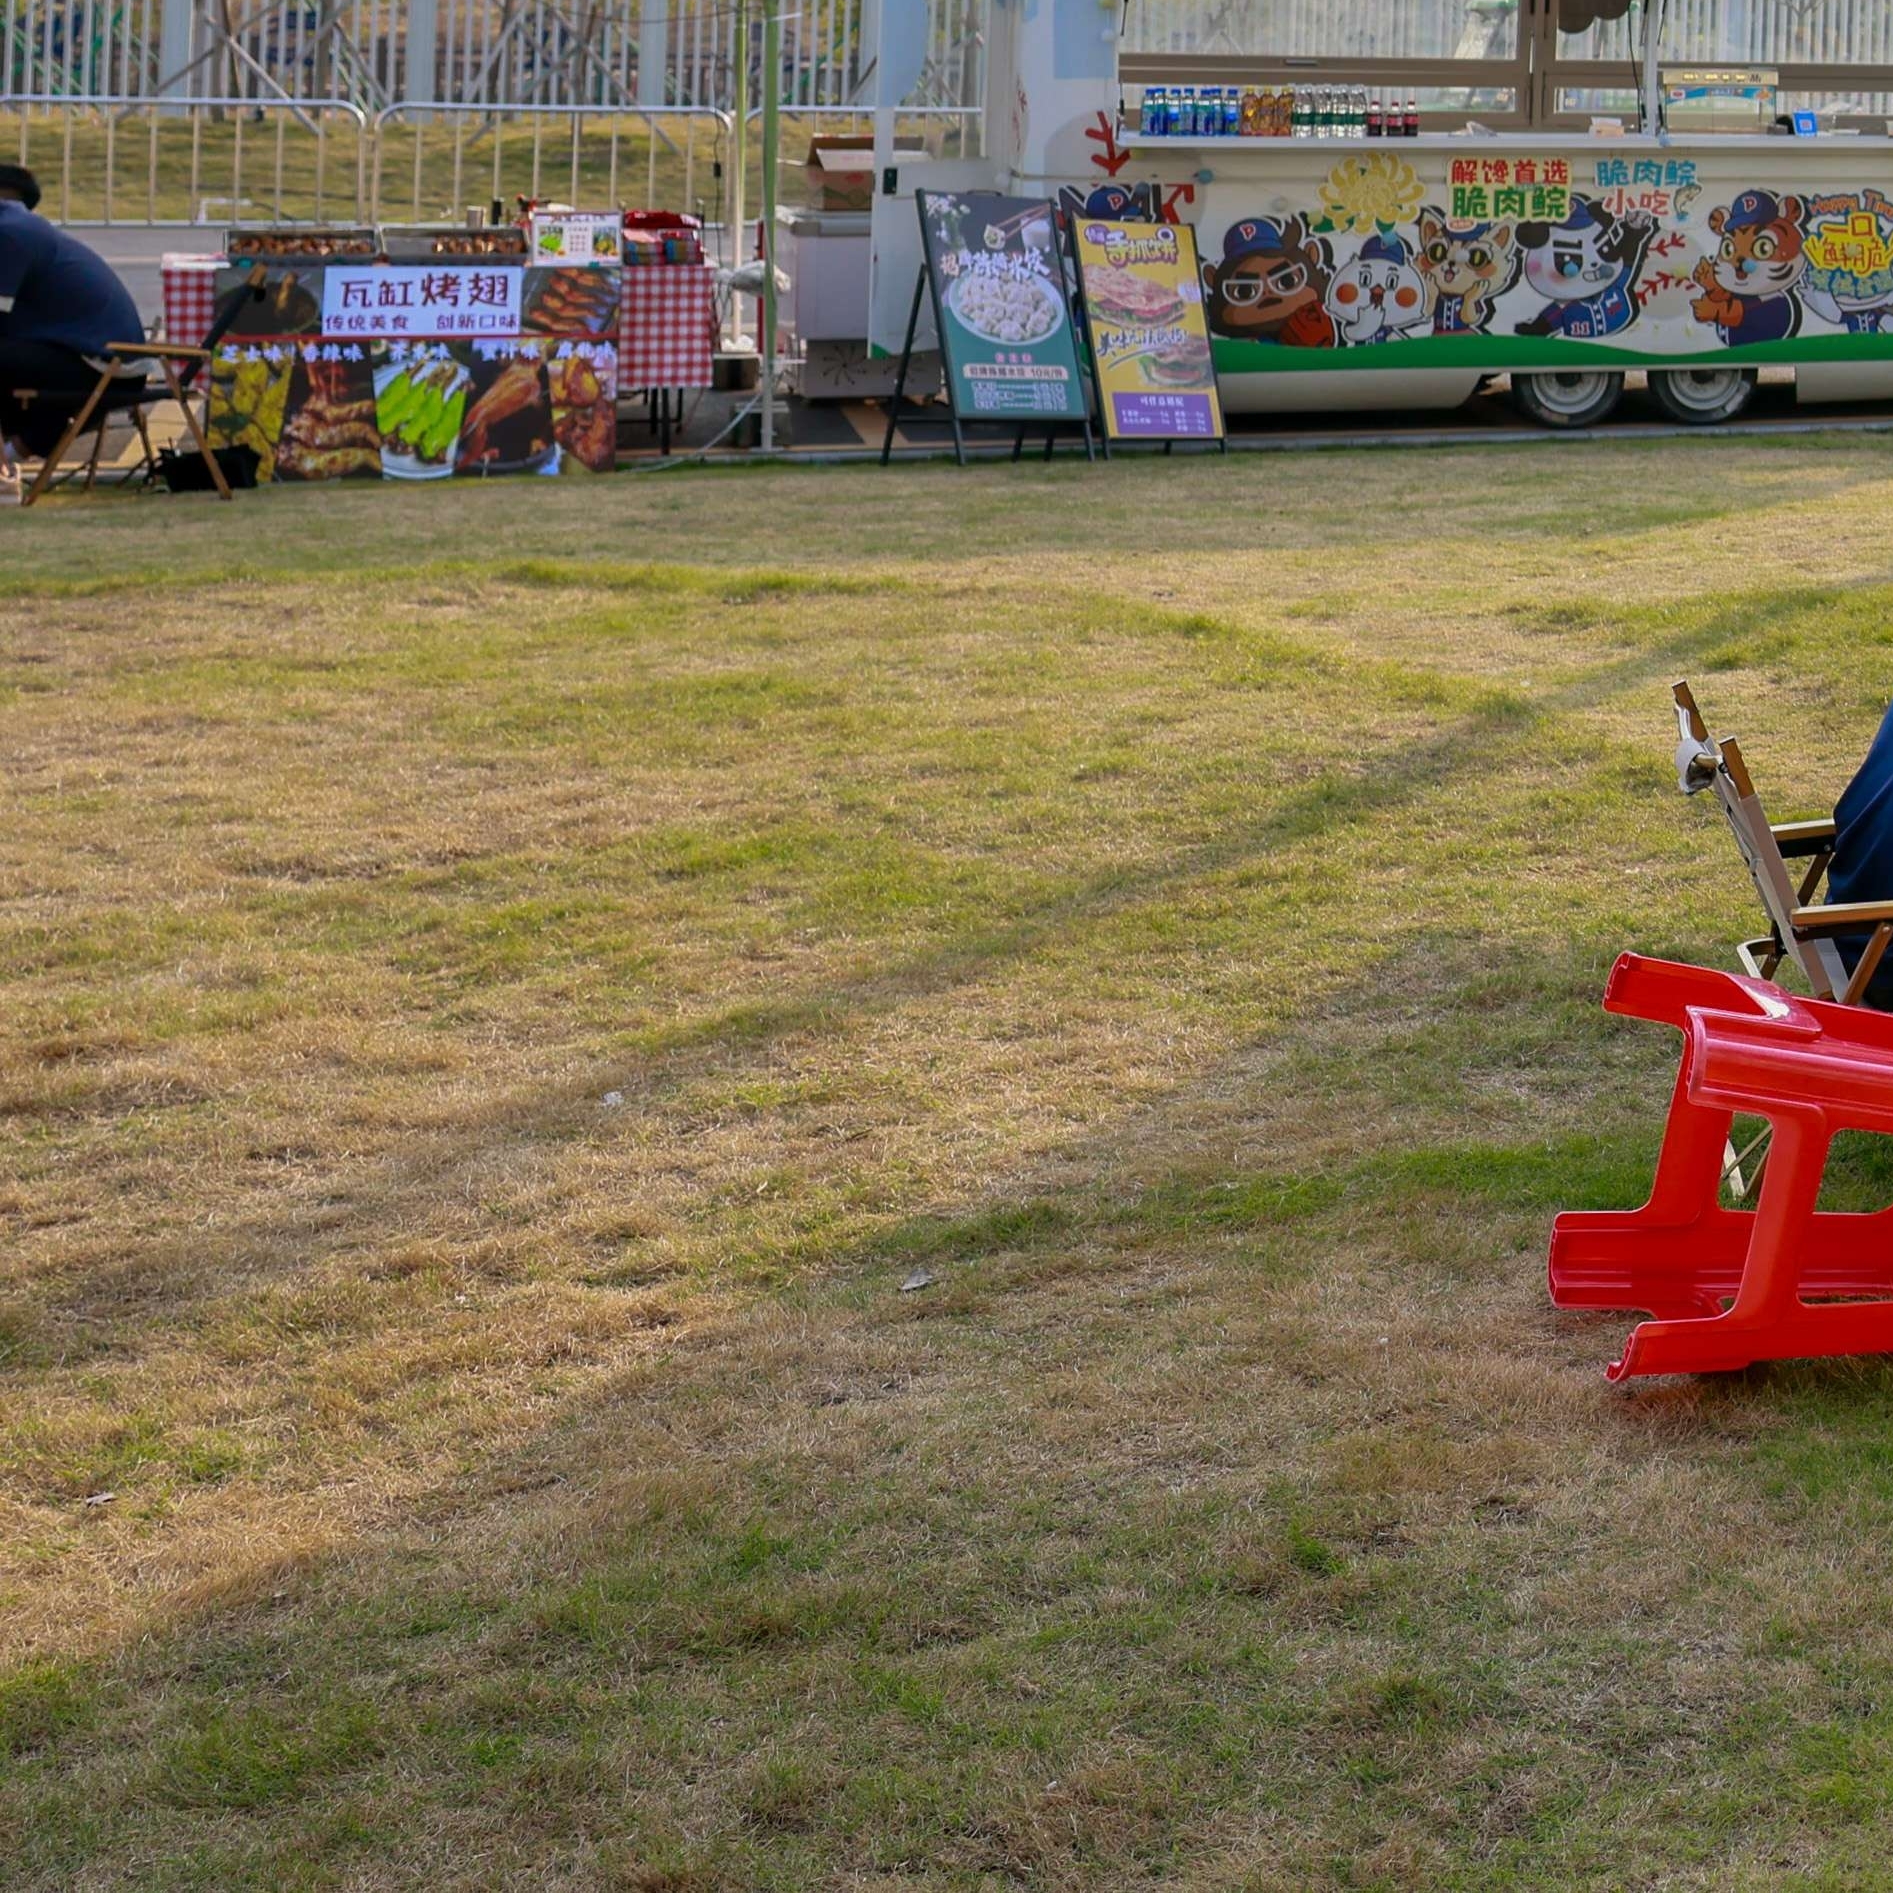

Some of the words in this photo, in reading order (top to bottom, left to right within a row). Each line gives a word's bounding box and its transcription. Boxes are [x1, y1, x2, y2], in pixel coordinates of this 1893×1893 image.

[1451, 159, 1569, 185] 解馋首选
[1596, 159, 1697, 187] 脆肉鲩
[1452, 186, 1567, 219] 脆肉鲩
[1602, 188, 1671, 217] 小吃
[1104, 227, 1178, 267] 手抓饼
[340, 272, 509, 309] 瓦缸烤翅
[436, 313, 519, 332] 创新口味
